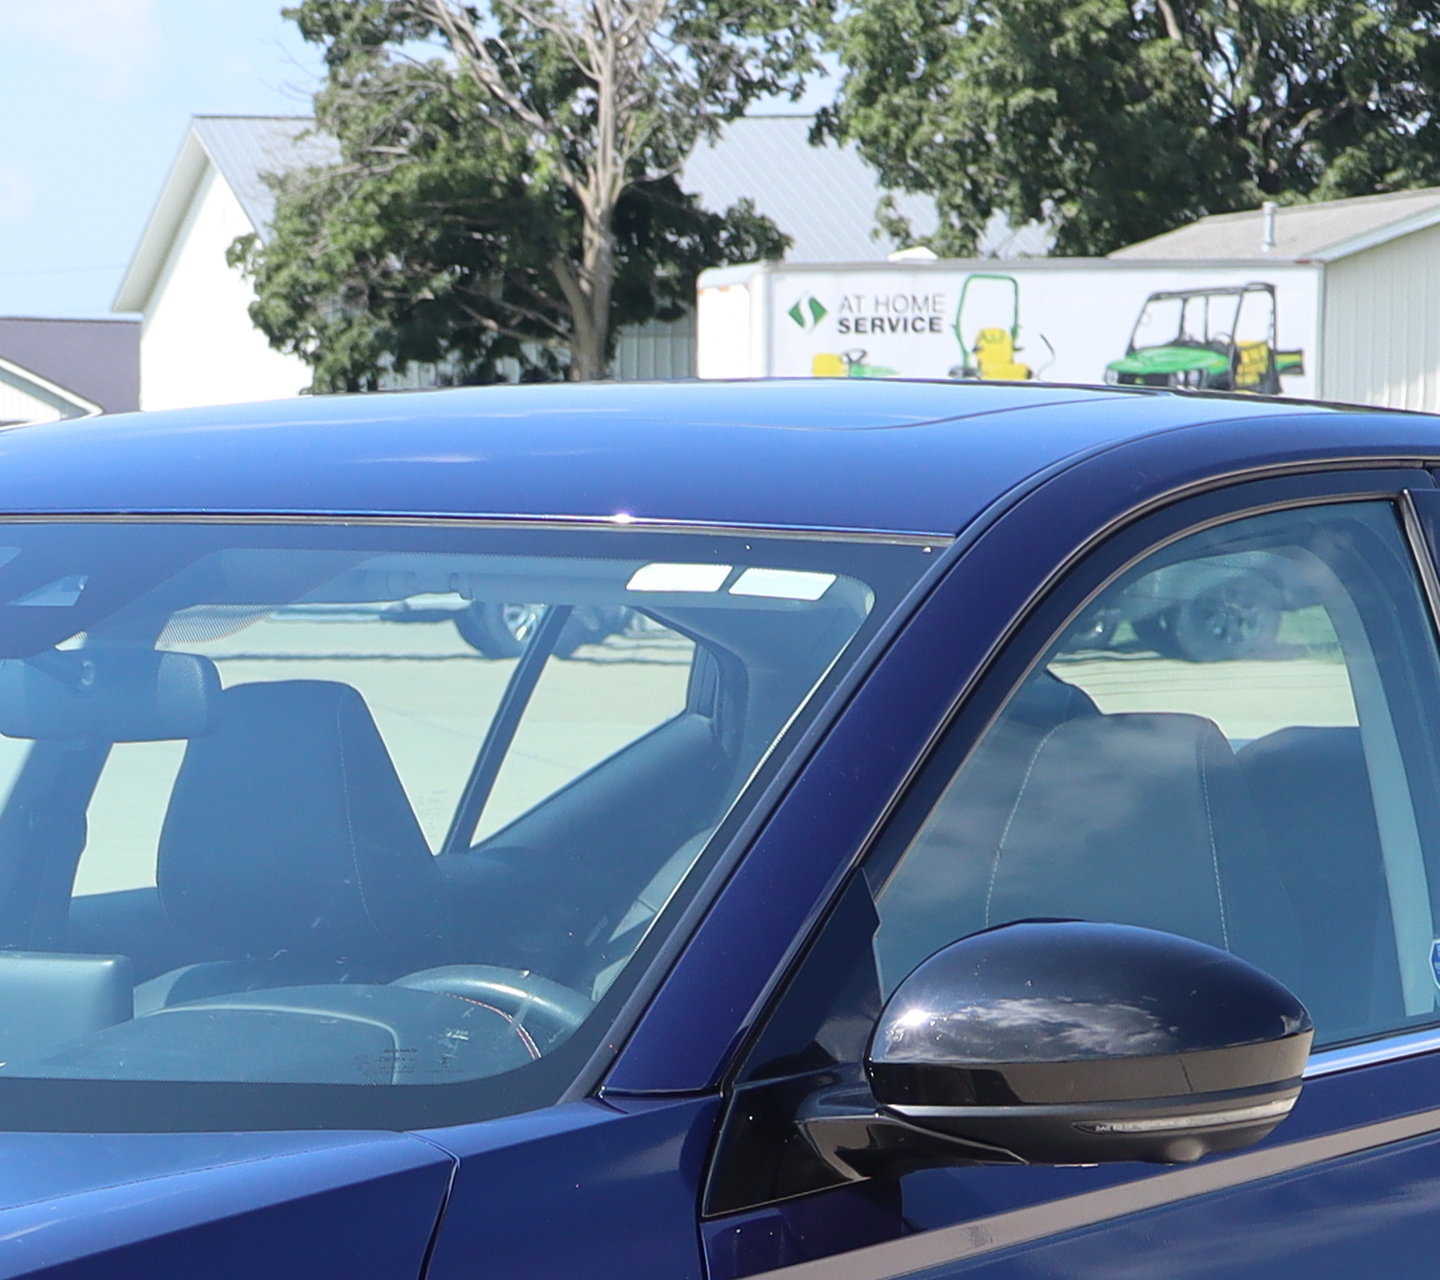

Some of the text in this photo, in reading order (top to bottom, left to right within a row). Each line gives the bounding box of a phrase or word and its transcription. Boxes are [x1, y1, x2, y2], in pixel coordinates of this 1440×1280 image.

[837, 294, 946, 314] AT HOME
[837, 316, 944, 335] SERVICE
